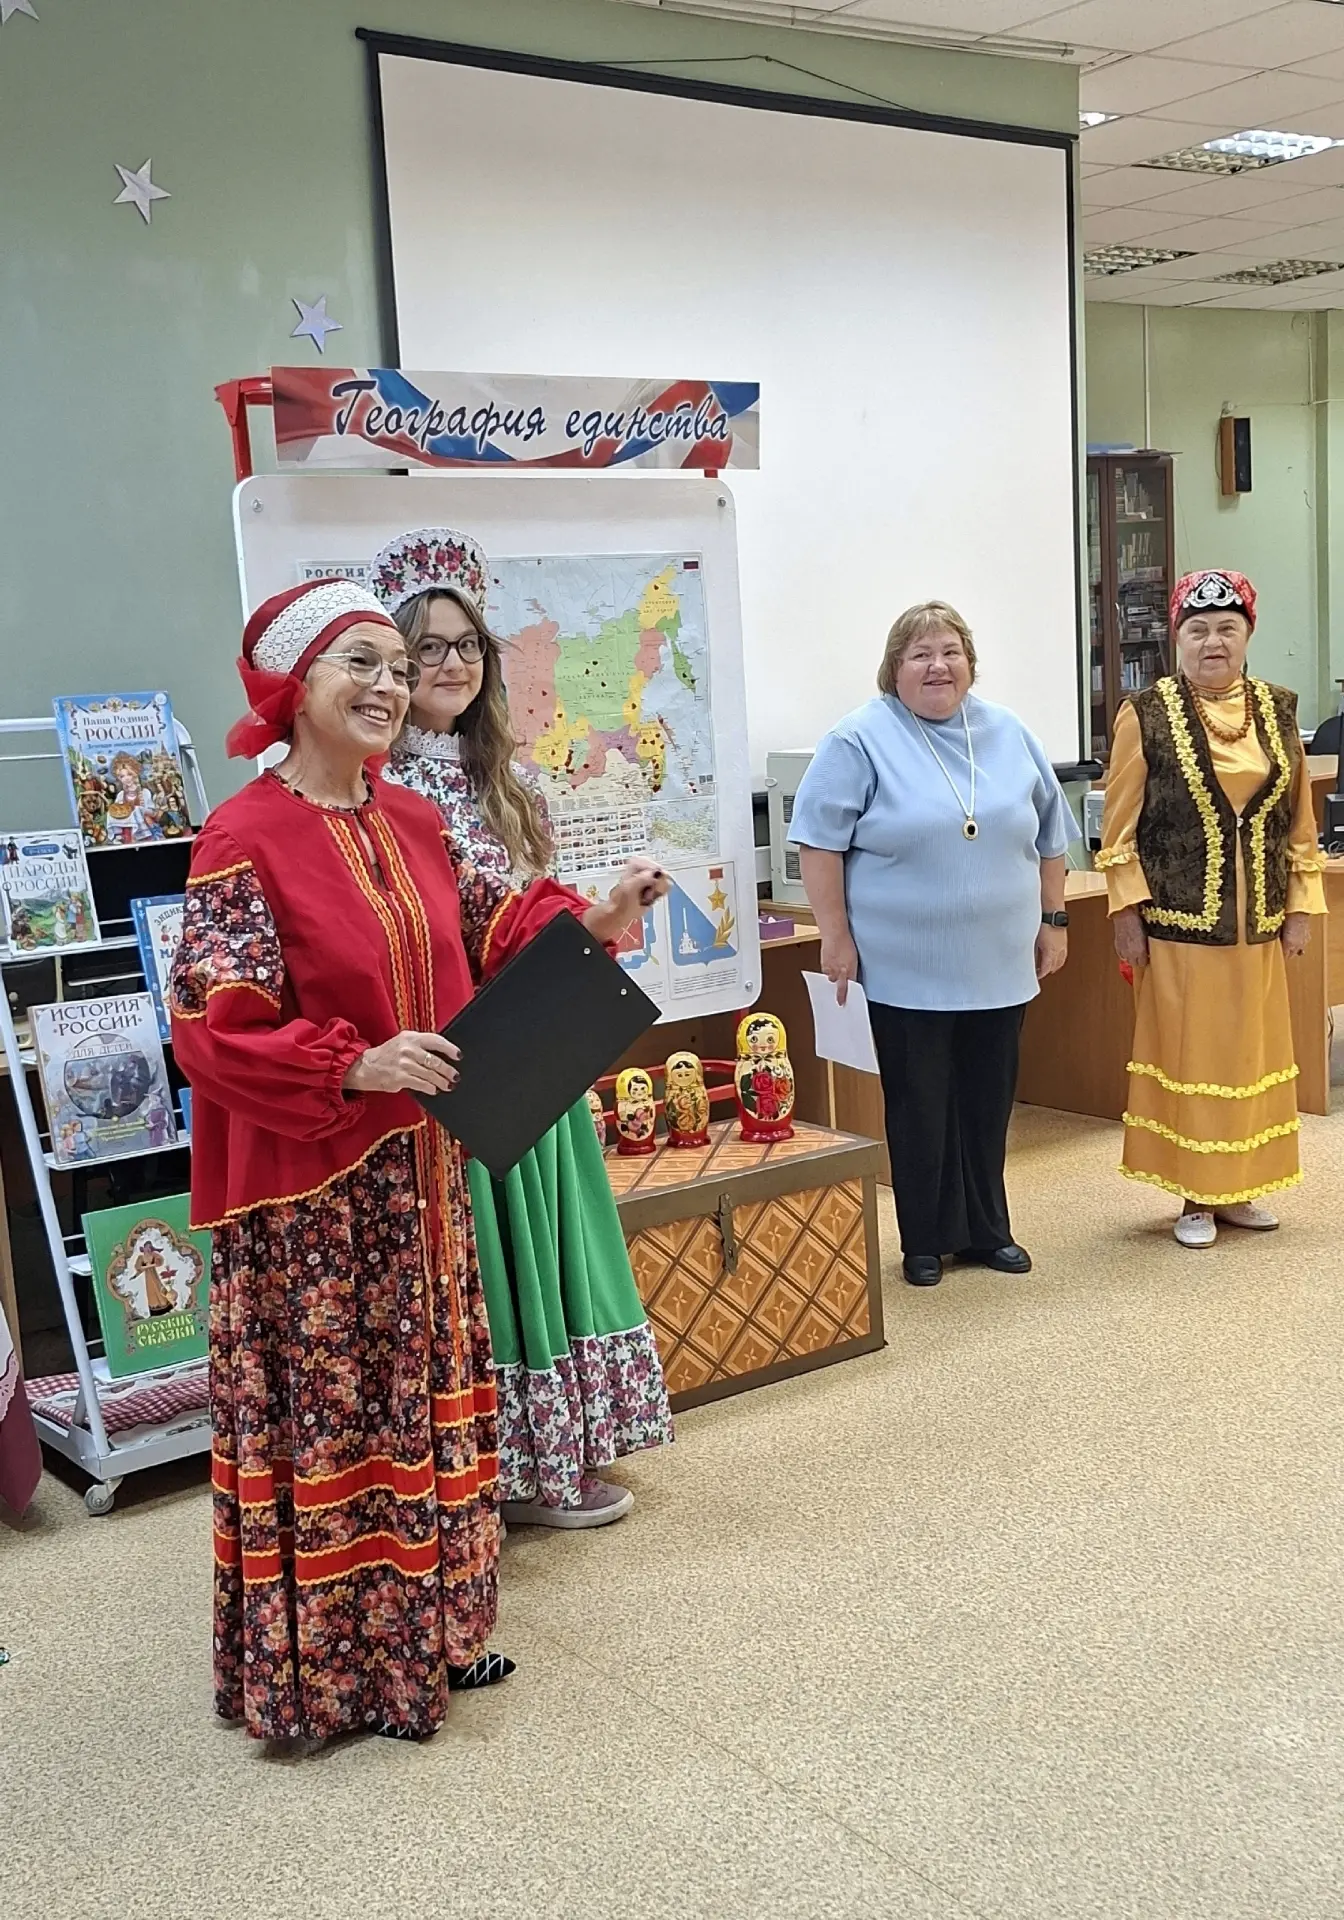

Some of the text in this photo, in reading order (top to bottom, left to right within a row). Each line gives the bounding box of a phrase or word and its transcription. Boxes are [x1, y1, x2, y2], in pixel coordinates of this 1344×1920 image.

[332, 380, 729, 456] География единства
[305, 567, 365, 579] РОССИЯ
[113, 715, 149, 725] Родина
[85, 724, 156, 741] РОССИЯ
[9, 861, 79, 878] НАРОДЫ
[15, 876, 79, 892] РОССИИ
[51, 998, 140, 1021] ИСТОРИЯ
[58, 1014, 138, 1036] РОССИИ
[72, 1047, 95, 1059] ДЛЯ
[136, 1313, 195, 1336] РУССКИЕ
[138, 1324, 195, 1347] СКАЗКИ
